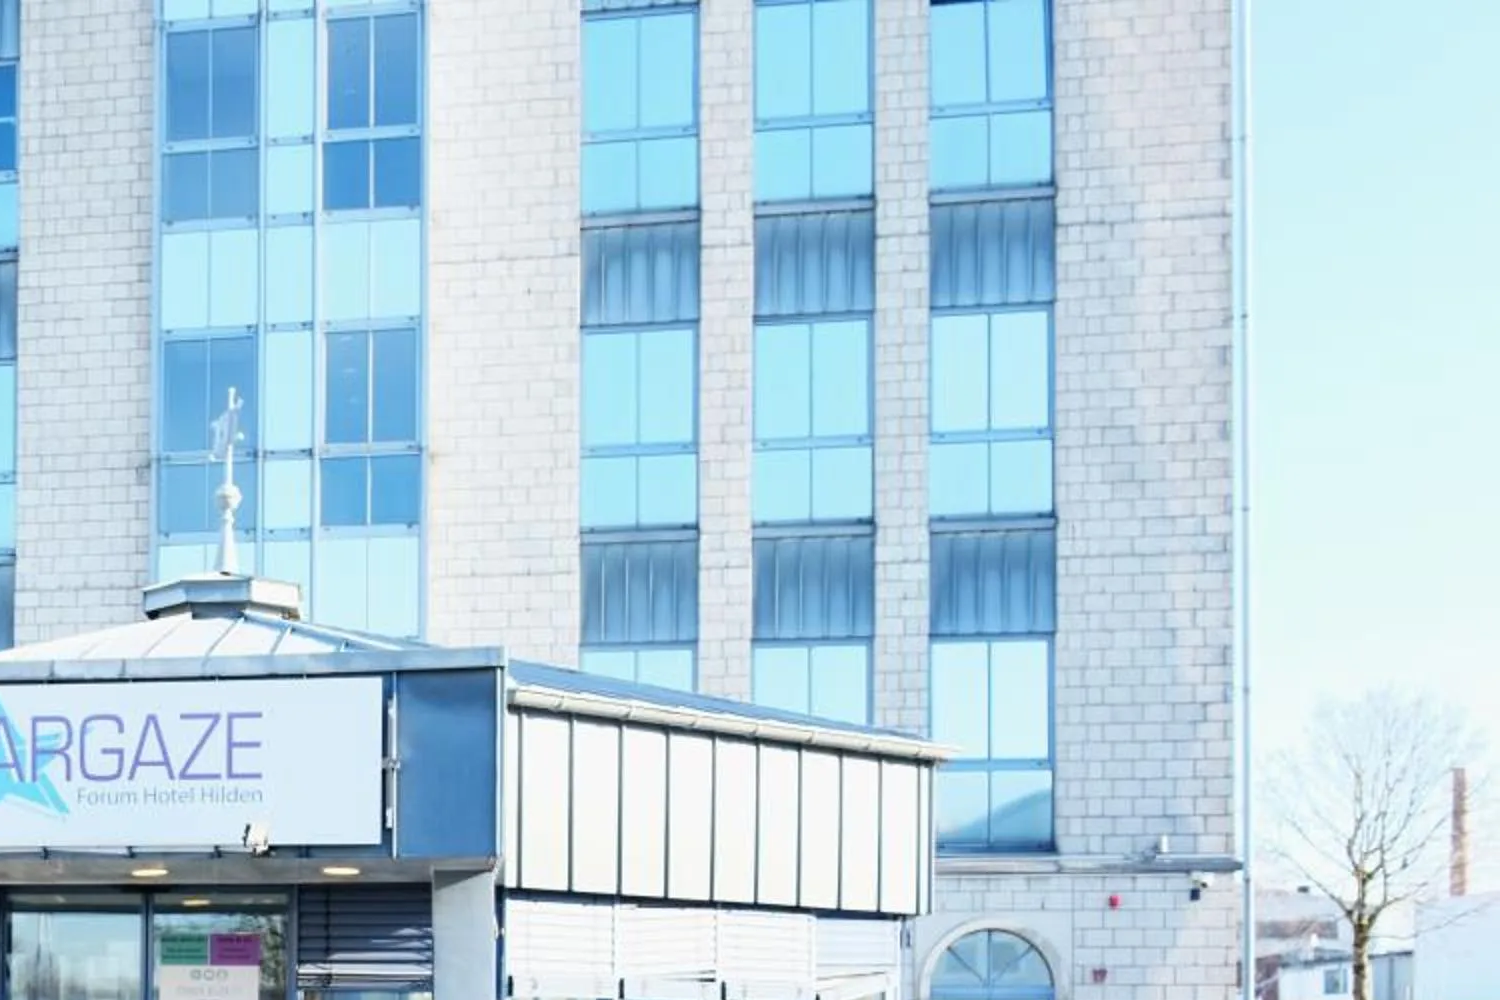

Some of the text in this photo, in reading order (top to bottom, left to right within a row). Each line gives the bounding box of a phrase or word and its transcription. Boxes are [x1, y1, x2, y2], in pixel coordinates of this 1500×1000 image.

[77, 785, 263, 805] Forum Hotel Hilden
